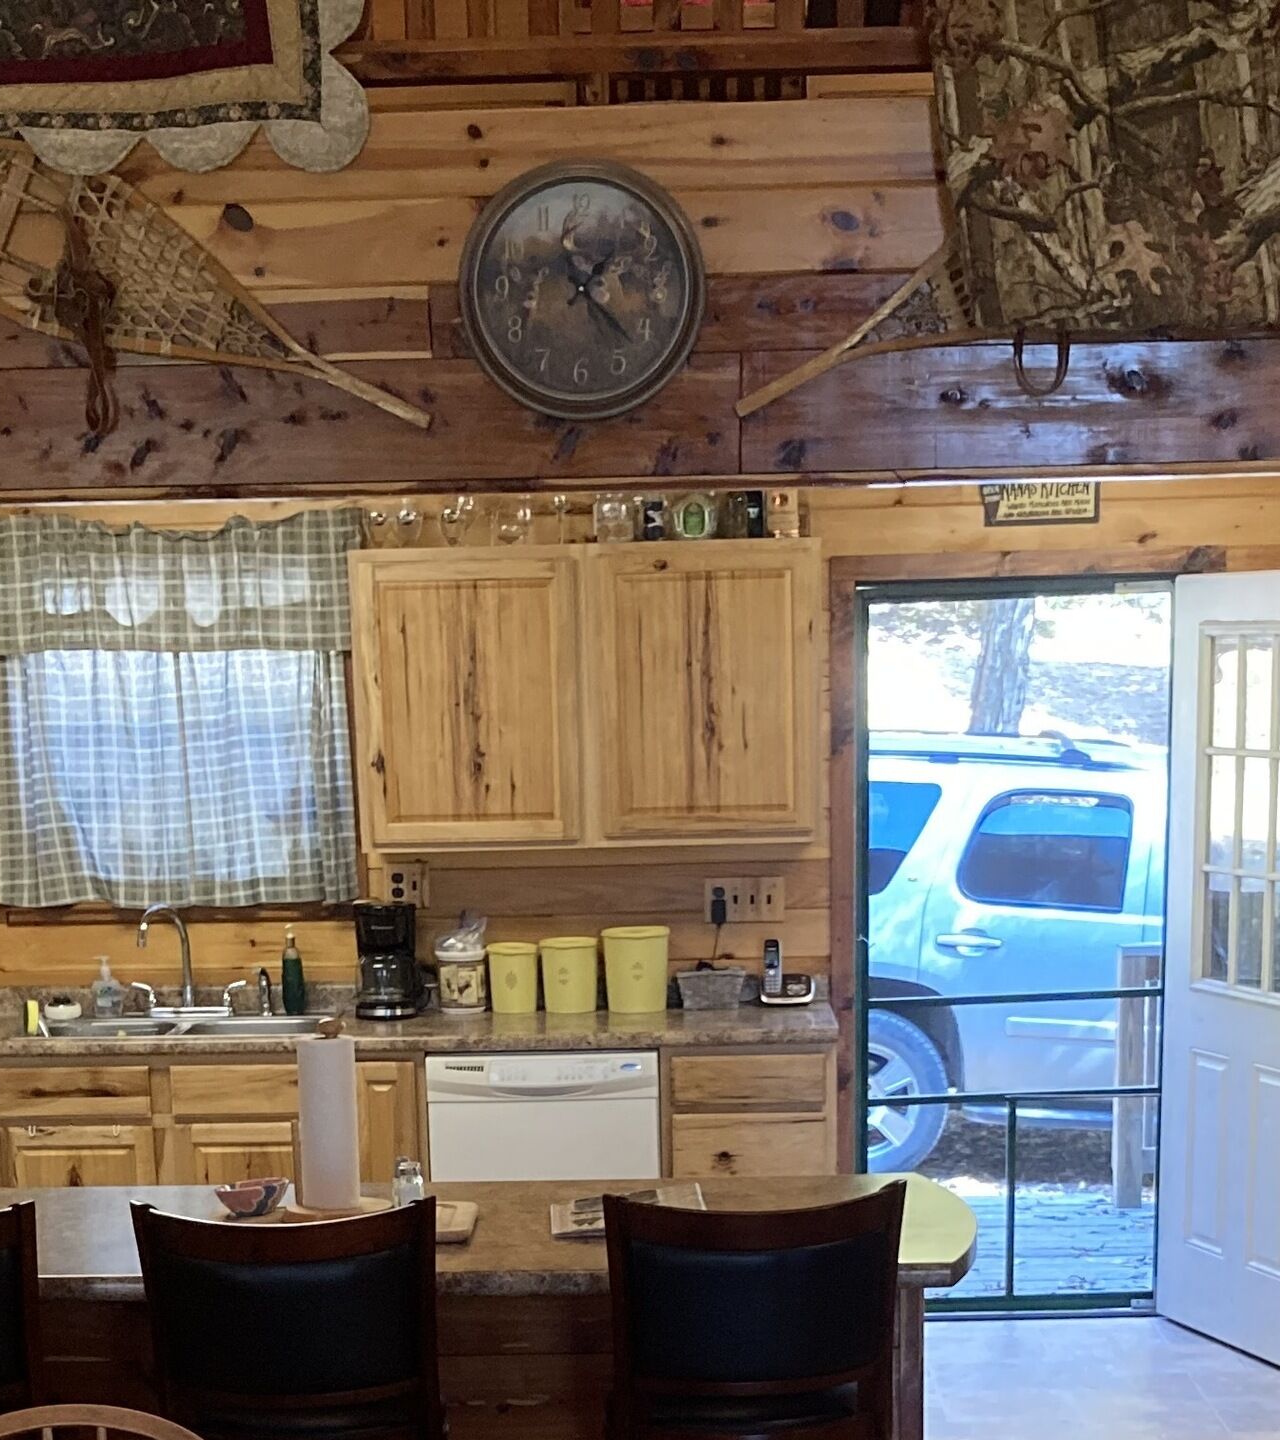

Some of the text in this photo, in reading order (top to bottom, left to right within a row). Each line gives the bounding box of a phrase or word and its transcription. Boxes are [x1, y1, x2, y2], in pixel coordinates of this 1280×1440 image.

[537, 206, 550, 231] 11
[643, 234, 658, 262] 2
[494, 276, 509, 300] 9
[507, 315, 522, 343] 8
[639, 318, 653, 341] 4
[534, 348, 550, 372] 7
[573, 358, 589, 385] 6
[610, 349, 626, 375] 5
